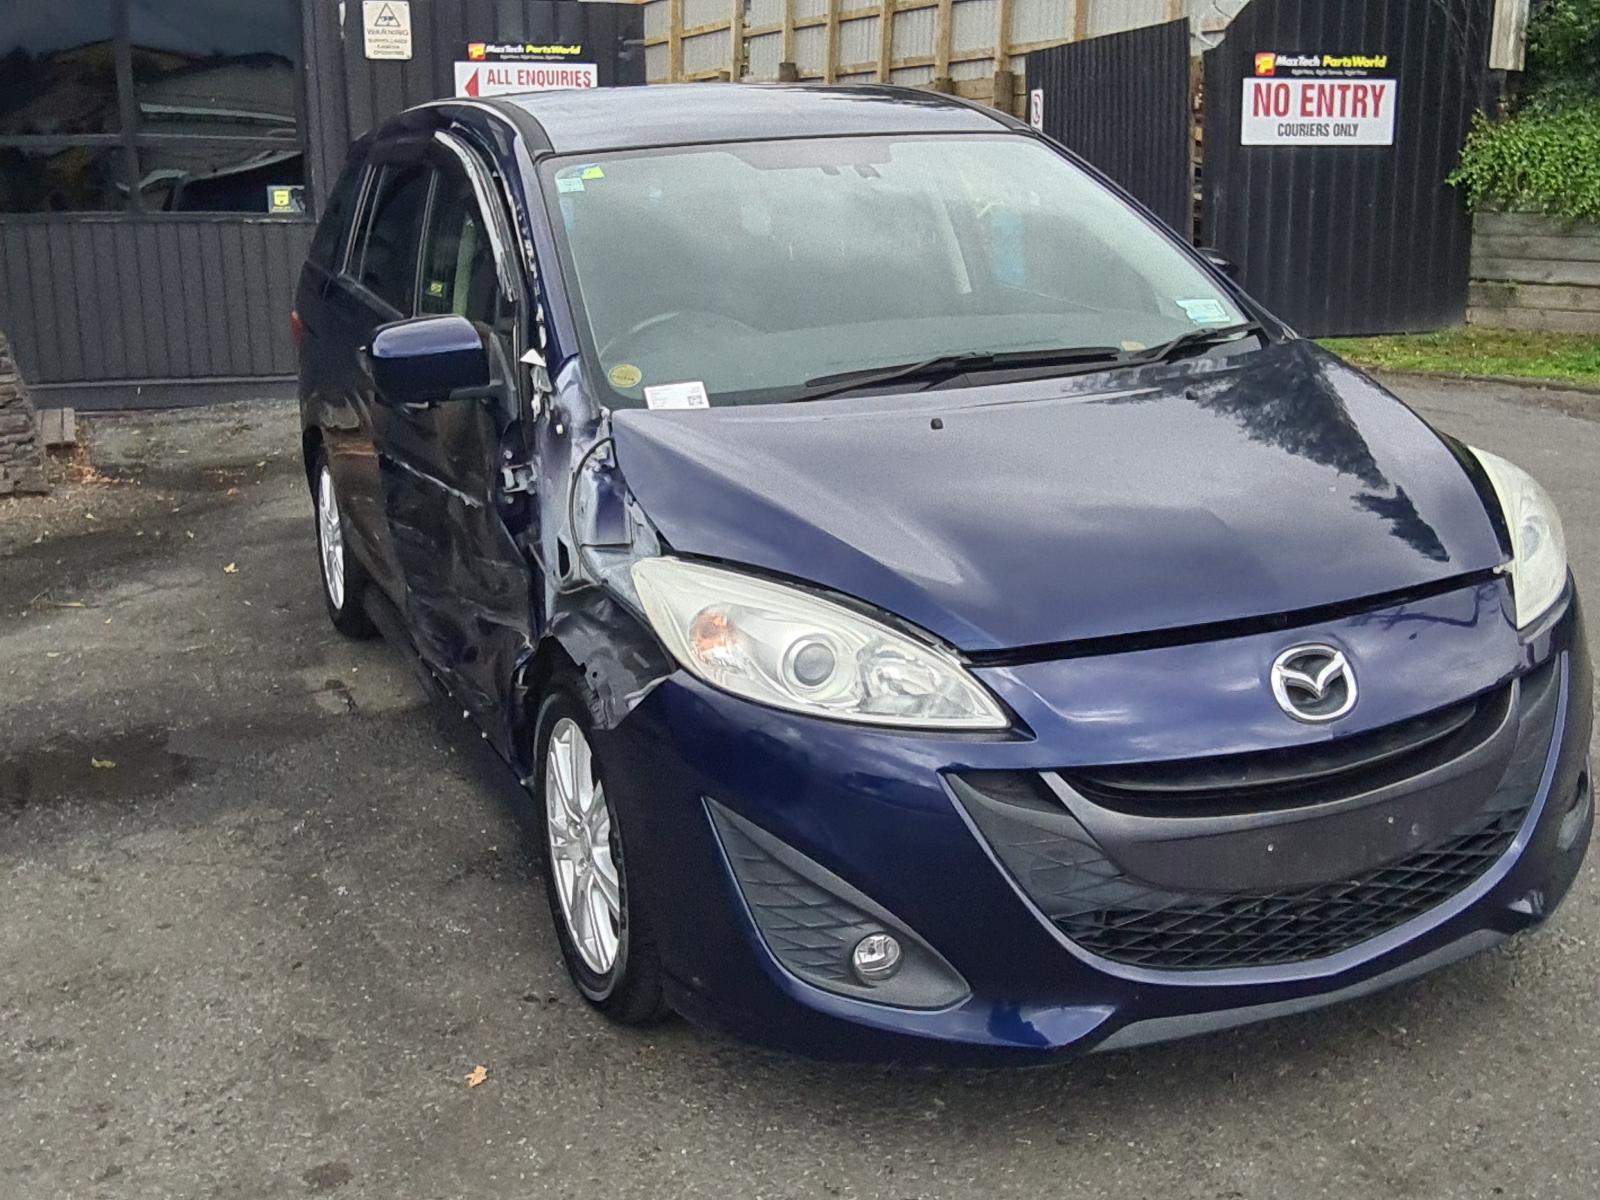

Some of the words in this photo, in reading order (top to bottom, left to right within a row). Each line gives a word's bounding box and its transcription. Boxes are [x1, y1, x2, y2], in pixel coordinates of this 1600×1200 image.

[1275, 55, 1321, 67] MaxTech
[1323, 55, 1388, 68] PartsWorld
[486, 69, 513, 85] ALL
[517, 69, 592, 88] ENQUIRIES
[1252, 83, 1290, 118] NO
[1299, 83, 1386, 119] ENTRY
[1278, 123, 1330, 137] COURIERS
[1332, 123, 1359, 137] ONLY
